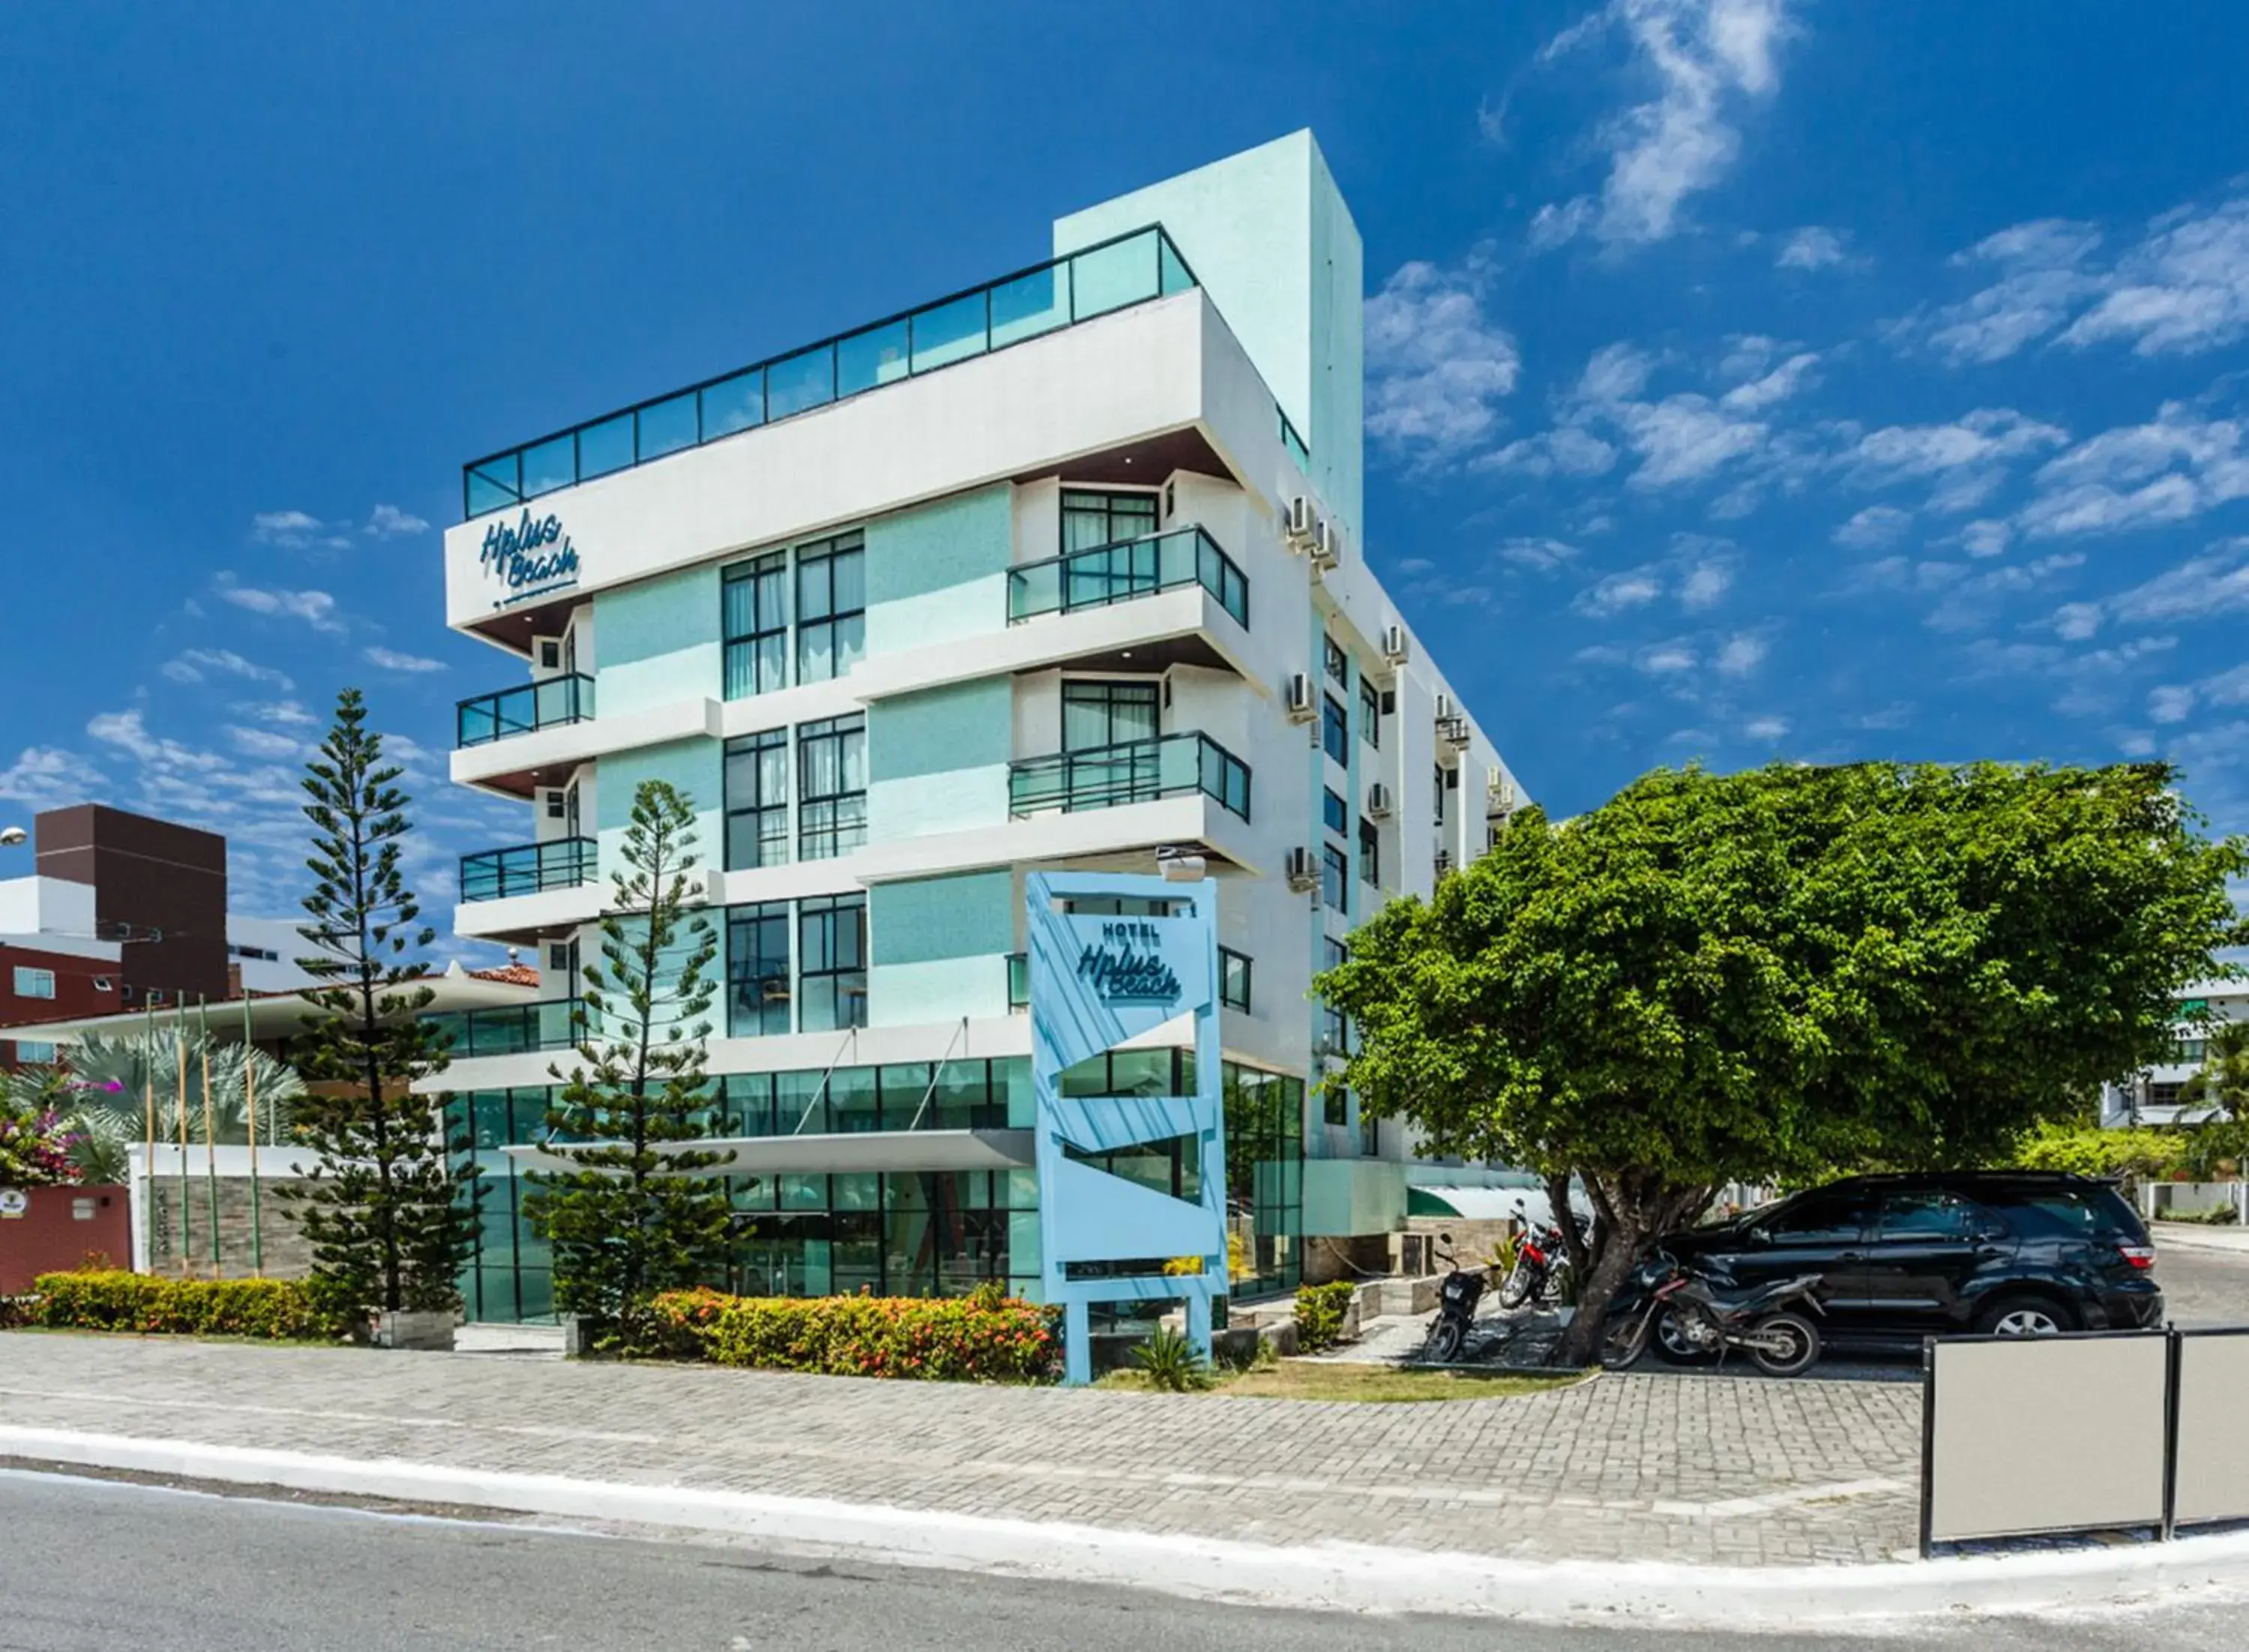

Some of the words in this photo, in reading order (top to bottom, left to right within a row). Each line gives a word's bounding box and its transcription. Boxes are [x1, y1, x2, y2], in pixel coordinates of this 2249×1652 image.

[480, 507, 562, 576] Hplus
[508, 534, 581, 588] Beach
[1102, 923, 1160, 938] HOTEL
[1077, 943, 1166, 988] Hplus
[1110, 967, 1181, 995] Beach
